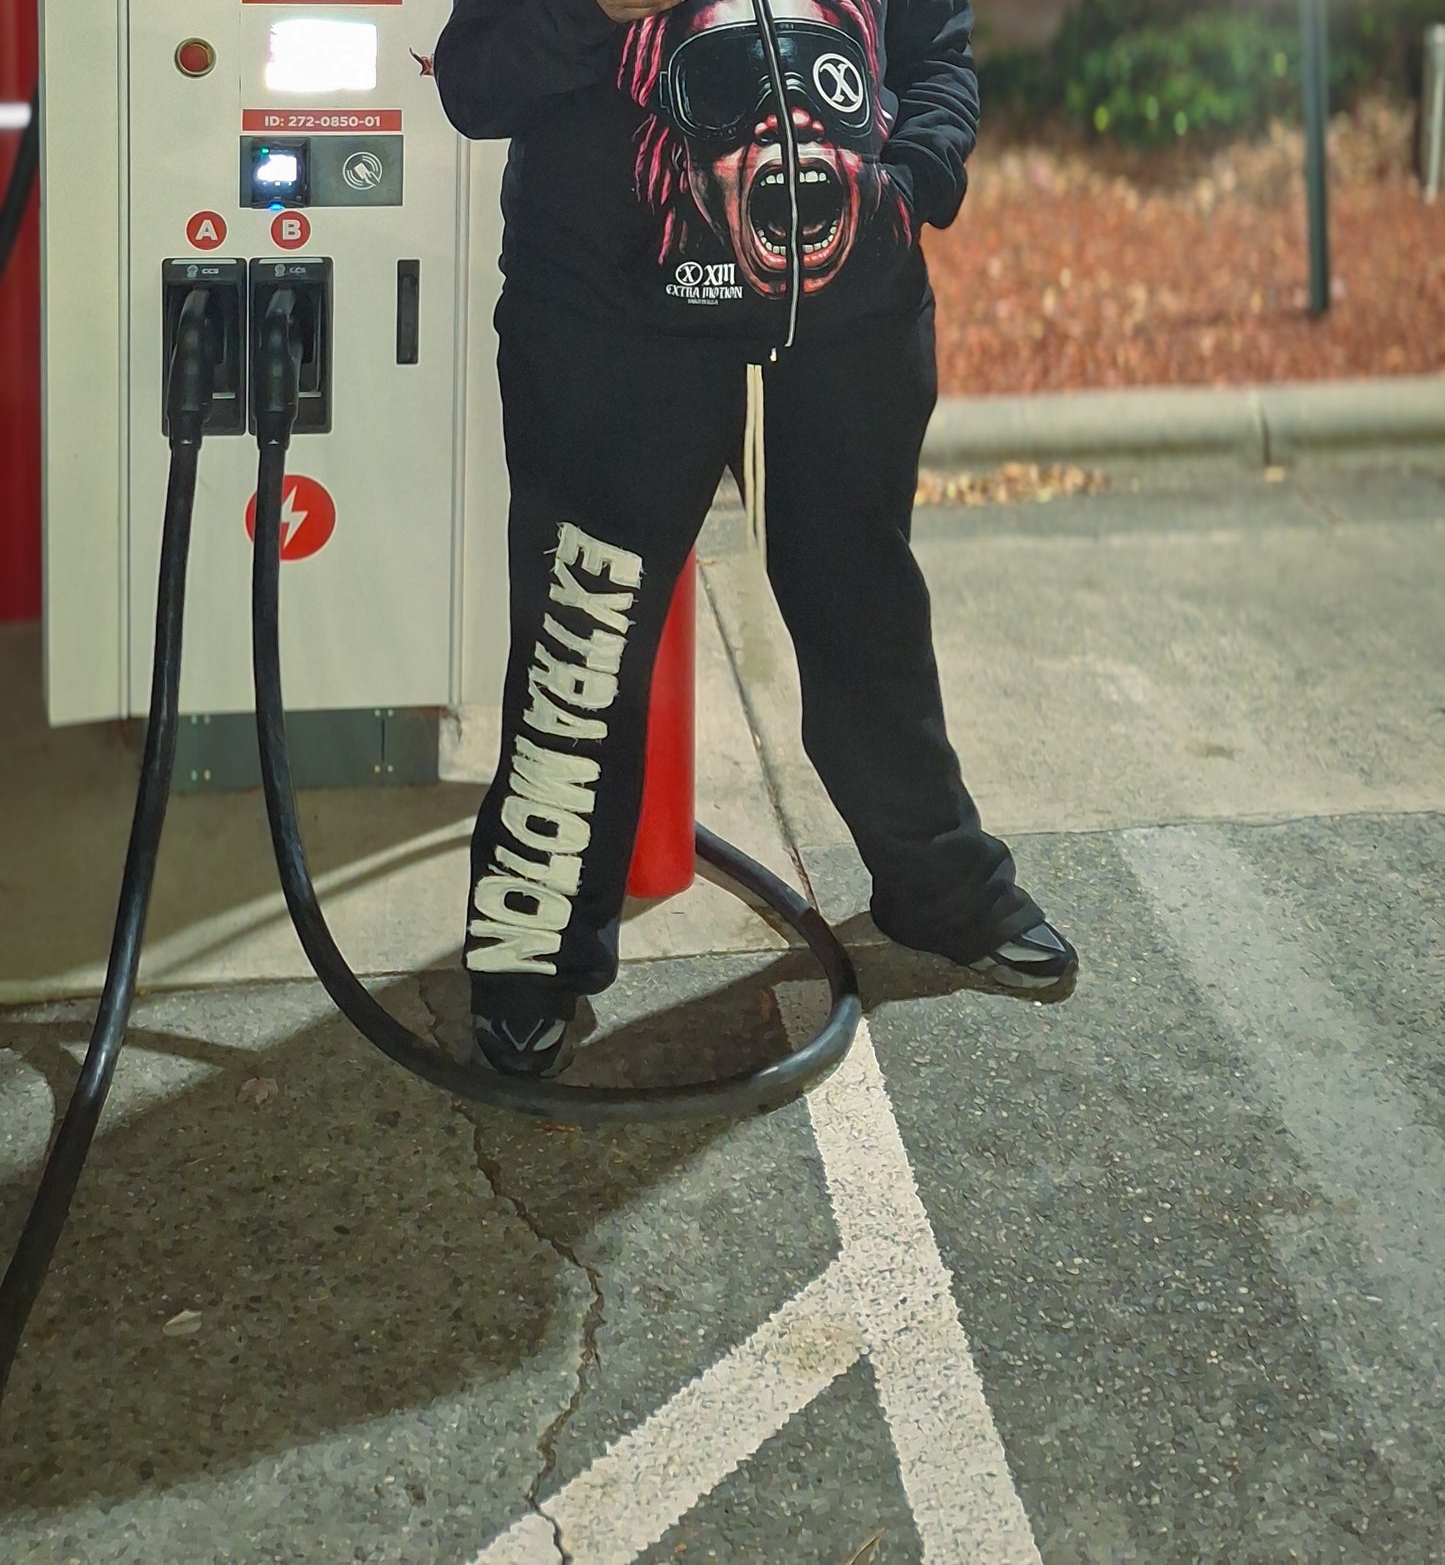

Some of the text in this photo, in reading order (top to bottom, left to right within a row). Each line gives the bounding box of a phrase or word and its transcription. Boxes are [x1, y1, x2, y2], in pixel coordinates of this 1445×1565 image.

[818, 60, 861, 106] X
[264, 115, 381, 128] ID: 272-0850-01
[195, 219, 219, 241] A
[282, 219, 302, 241] B
[666, 284, 700, 298] EXTRA
[466, 522, 645, 976] EXTRA MOTON
